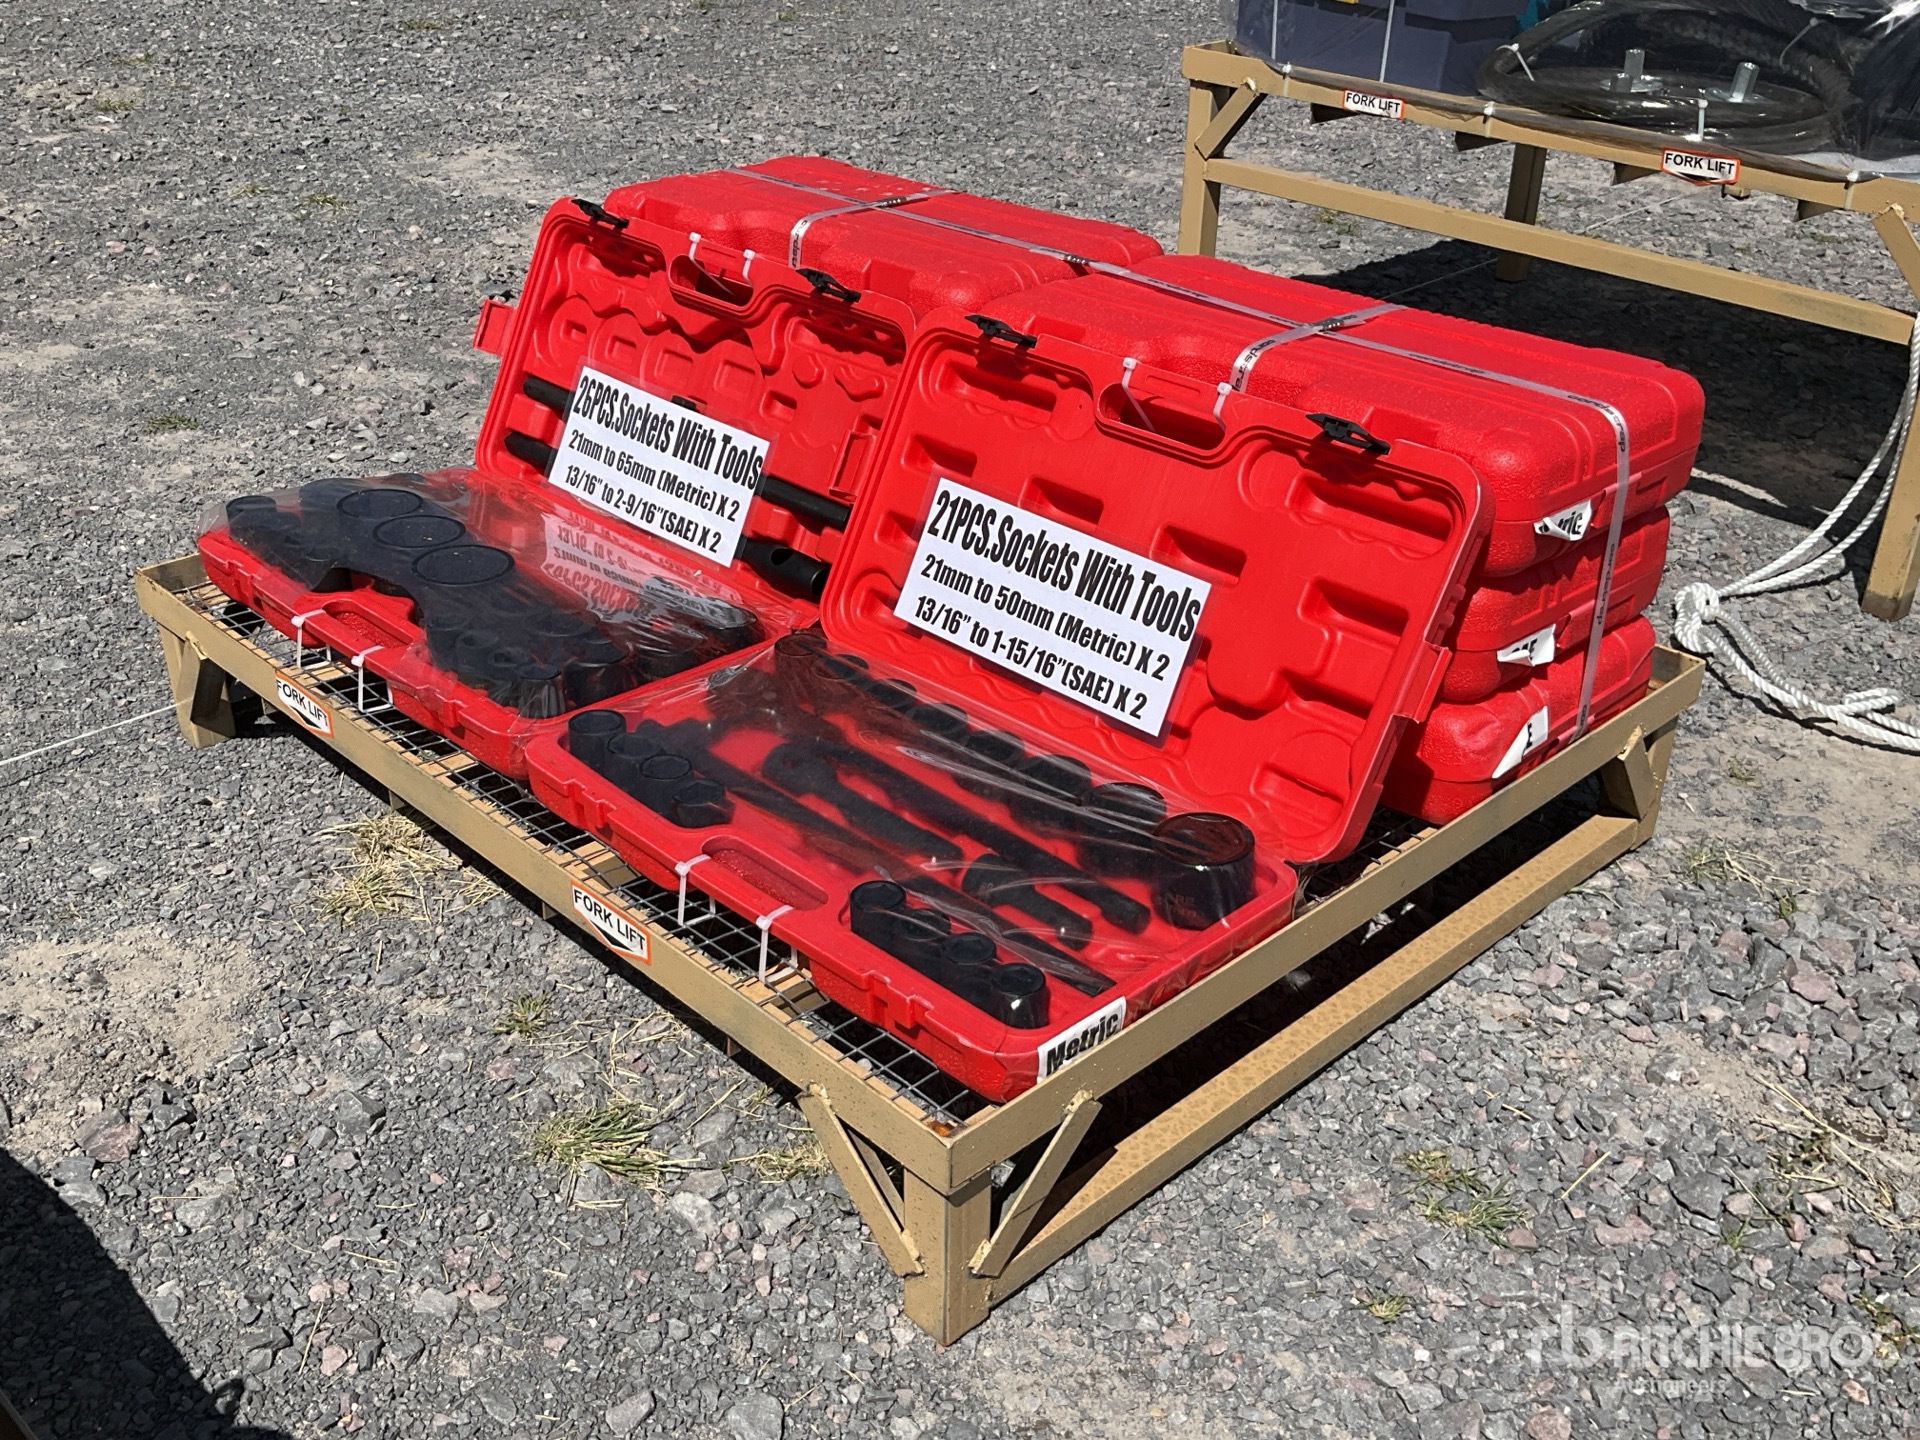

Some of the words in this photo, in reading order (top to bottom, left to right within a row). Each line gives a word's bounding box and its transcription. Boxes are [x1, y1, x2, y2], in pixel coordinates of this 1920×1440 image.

[1346, 93, 1376, 108] FORK
[1379, 99, 1401, 113] LIFT
[1665, 153, 1703, 169] FORK
[1707, 159, 1735, 174] LIFT
[573, 374, 675, 453] 26PCS.Sockets
[672, 417, 717, 470] With
[713, 434, 763, 490] Tools
[568, 429, 603, 461] 21mm
[604, 446, 616, 467] to
[616, 451, 656, 486] 65mm
[657, 469, 717, 512] (Metric)
[716, 495, 730, 517] X
[727, 500, 740, 523] 2
[602, 483, 614, 504] to
[697, 526, 712, 549] X
[709, 532, 722, 553] 2
[928, 489, 1080, 591] 21PCS.Sockets
[1075, 549, 1135, 615] With
[1130, 570, 1200, 642] Tools
[921, 554, 974, 591] 21mm
[973, 577, 993, 604] to
[995, 585, 1060, 631] 50mm
[1055, 612, 1137, 666] (Metric)
[1134, 646, 1155, 674] X
[1151, 653, 1170, 681] 2
[276, 679, 307, 709] FORK
[308, 701, 329, 726] LIFT
[970, 621, 990, 647] to
[1112, 686, 1131, 713] X
[1129, 693, 1148, 720] 2
[574, 889, 613, 928] FORK
[617, 918, 645, 950] LIFT
[1046, 1013, 1119, 1076] Metric
